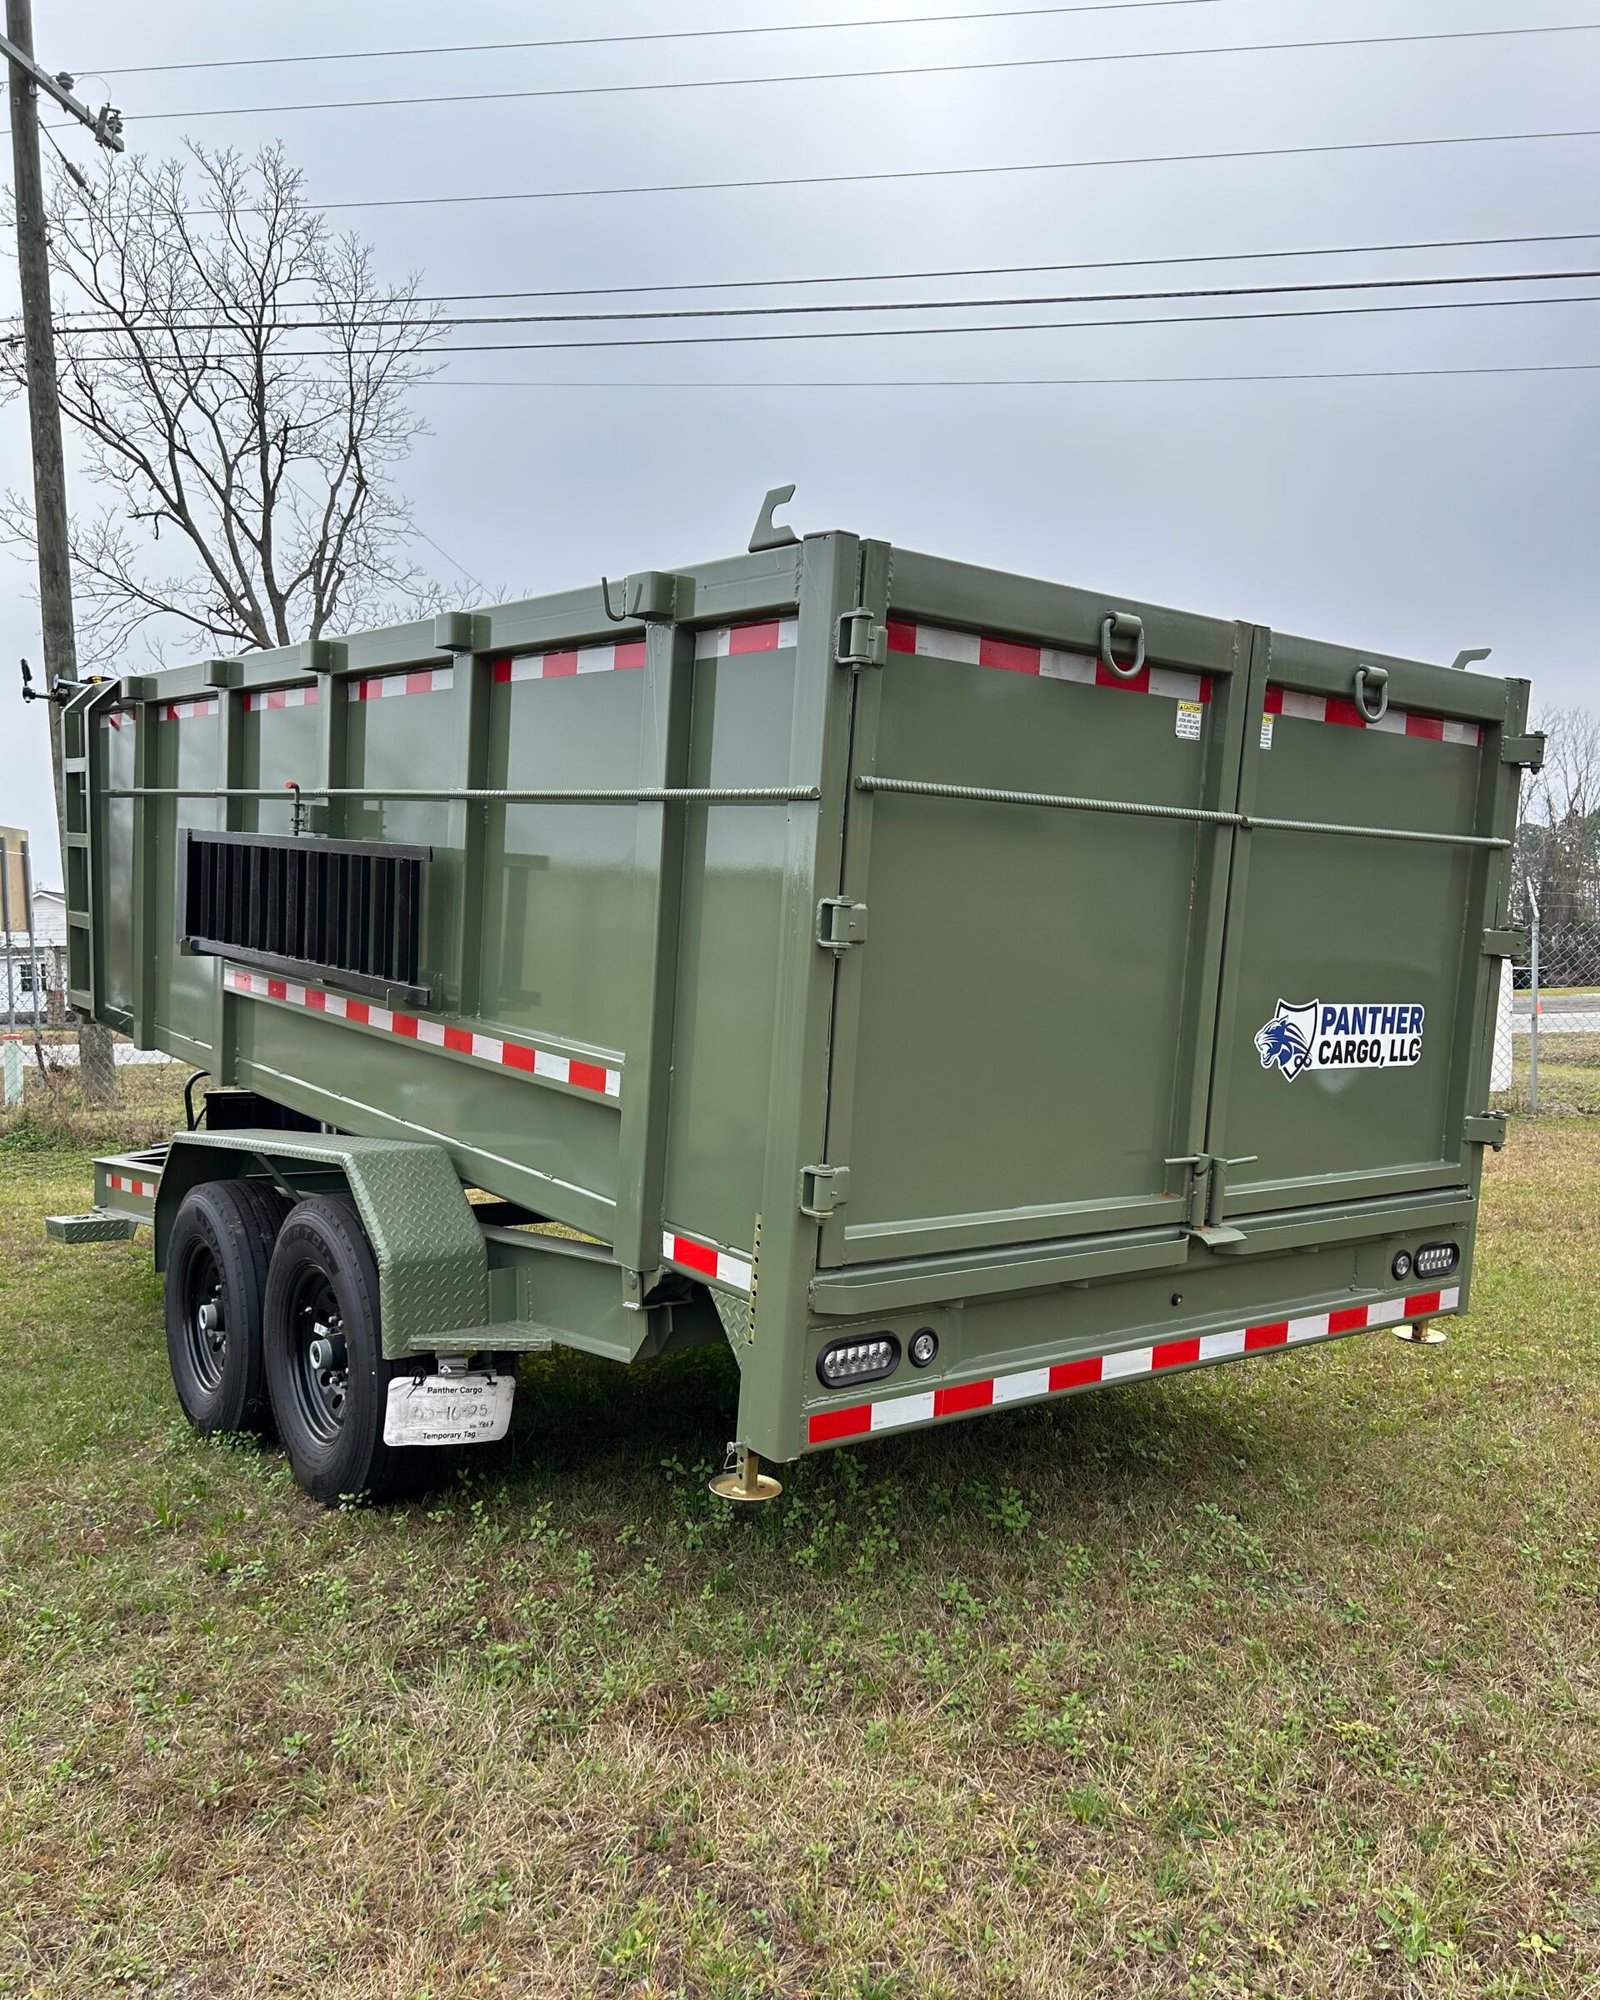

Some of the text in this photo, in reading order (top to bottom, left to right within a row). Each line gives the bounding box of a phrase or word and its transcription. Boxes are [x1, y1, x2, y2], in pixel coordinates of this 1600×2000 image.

[1320, 1006, 1423, 1036] PANTHER
[1318, 1038, 1421, 1066] CARGO, LLC
[427, 1386, 483, 1395] Panther Cargo
[423, 1431, 476, 1440] Temporary Tag
